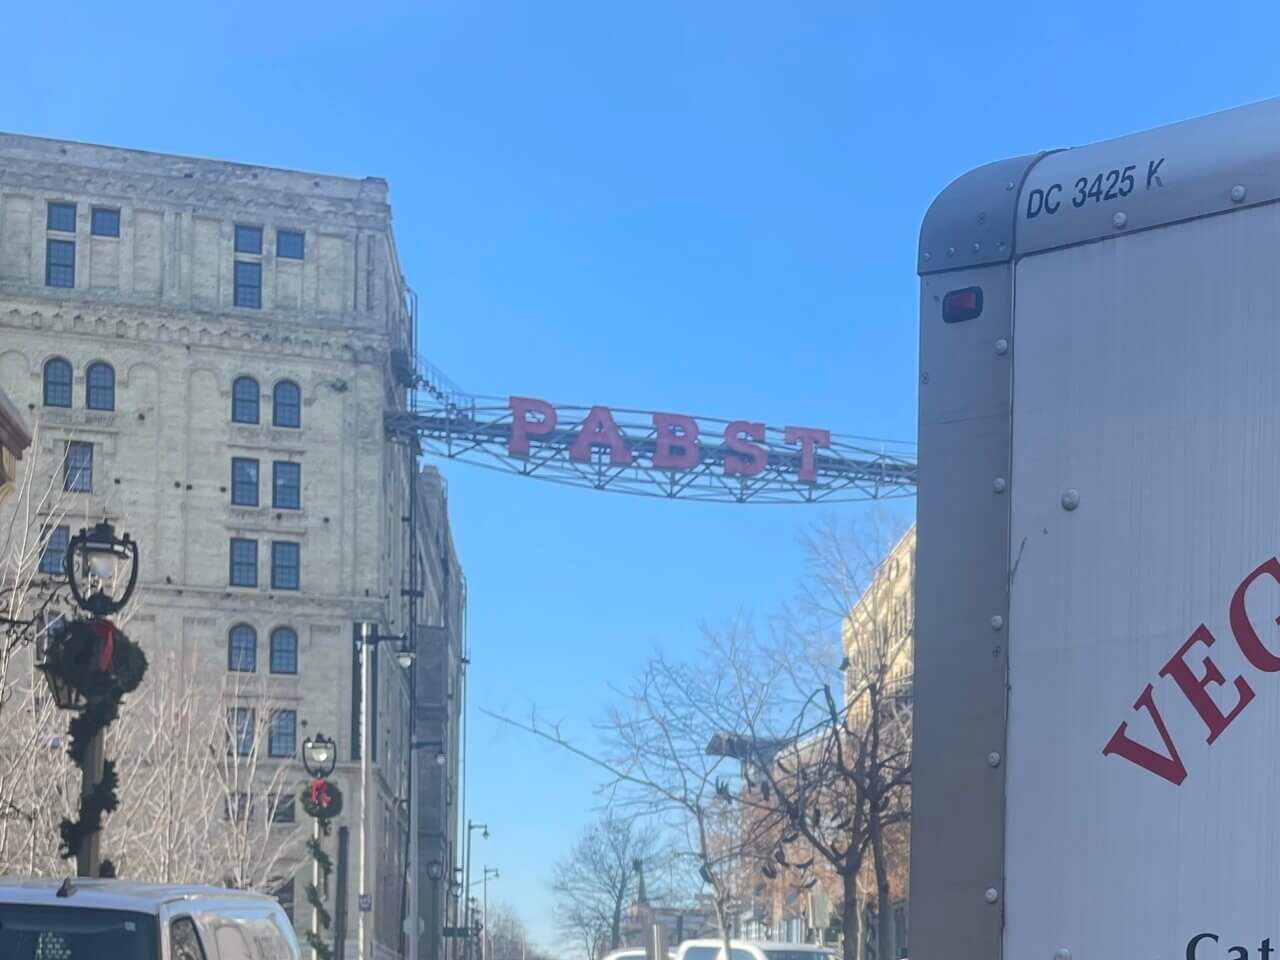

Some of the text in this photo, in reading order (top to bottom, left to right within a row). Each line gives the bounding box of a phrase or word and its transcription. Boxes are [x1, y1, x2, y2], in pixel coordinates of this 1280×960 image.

[1027, 157, 1165, 220] DC 3425 K
[508, 396, 831, 482] PABST
